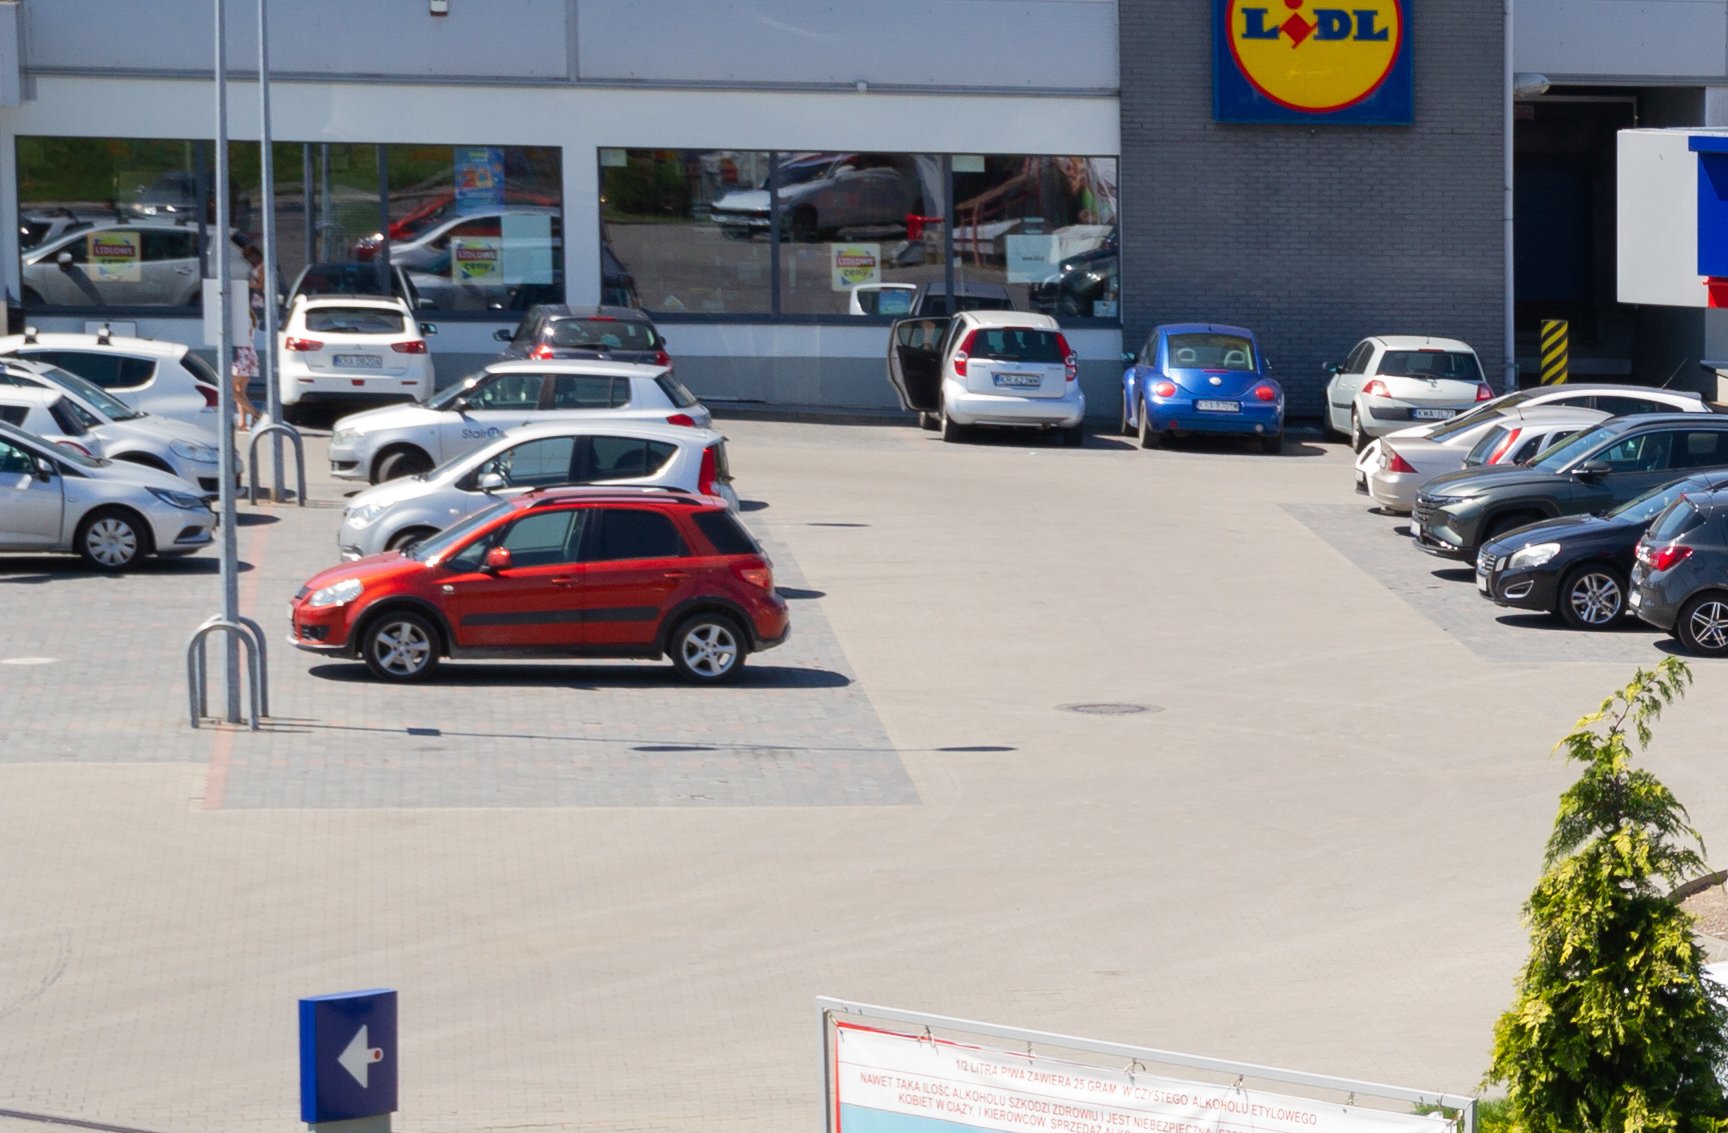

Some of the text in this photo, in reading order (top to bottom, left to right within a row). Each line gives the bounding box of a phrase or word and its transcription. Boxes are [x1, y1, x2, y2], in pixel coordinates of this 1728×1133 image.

[971, 1060, 998, 1076] LITRA
[1001, 1066, 1026, 1081] PIWA
[1027, 1071, 1072, 1088] ZAWIERA
[1074, 1078, 1085, 1090] 25
[1088, 1080, 1117, 1094] GRAM
[1122, 1086, 1133, 1097] W
[1135, 1087, 1188, 1106] CZYSTEGO
[1192, 1094, 1249, 1115] ALKOHOLU
[1251, 1104, 1317, 1126] ETYLOWEGO
